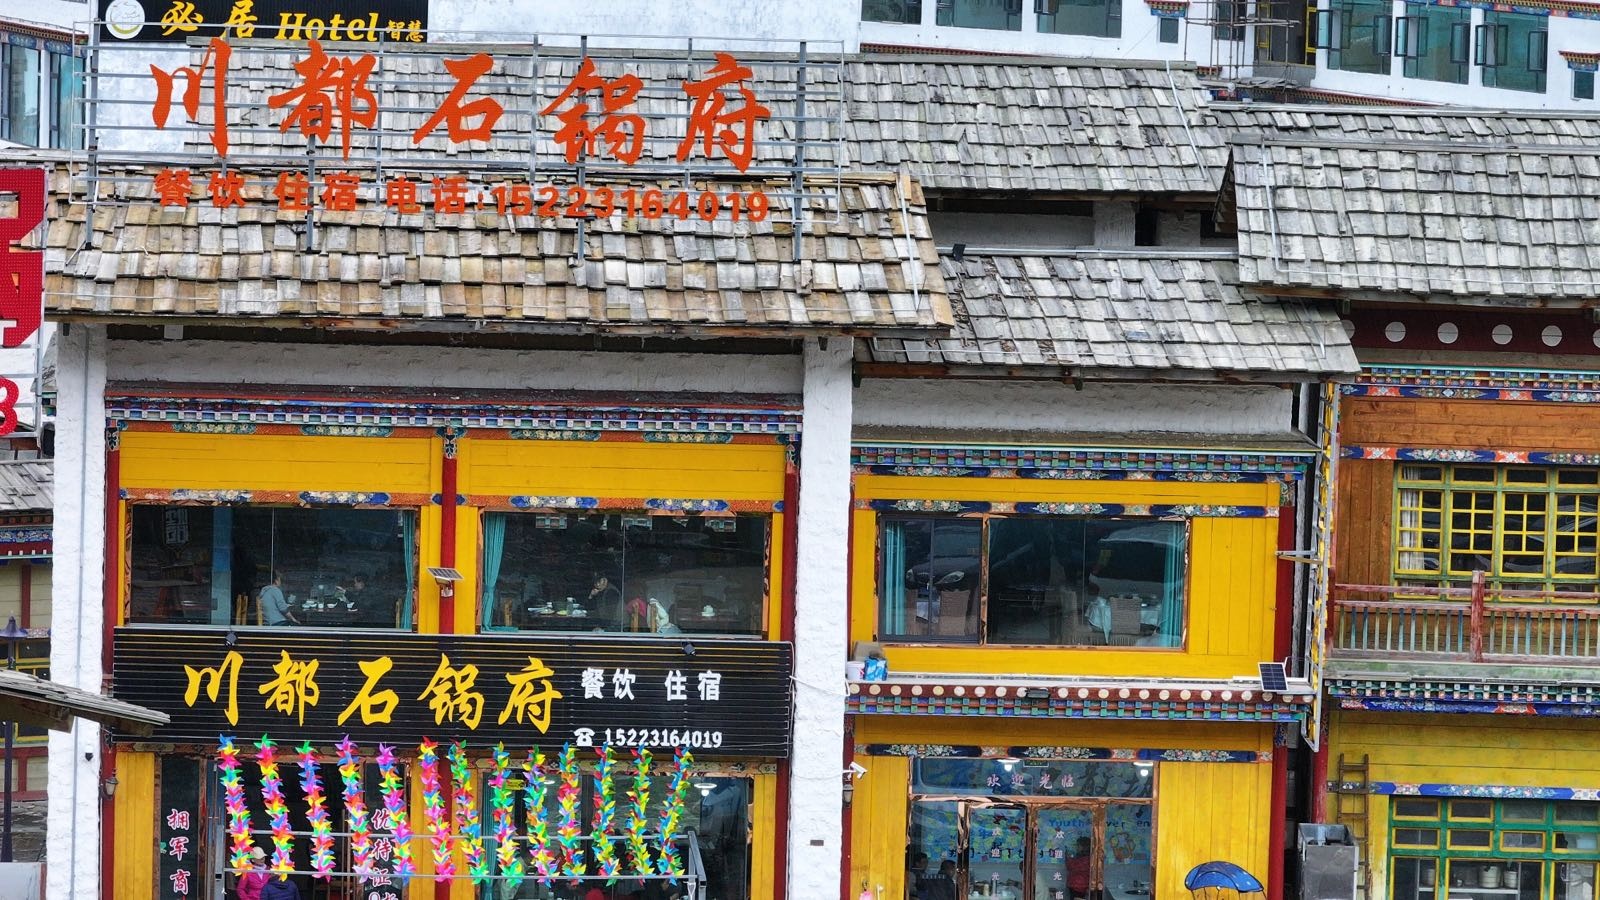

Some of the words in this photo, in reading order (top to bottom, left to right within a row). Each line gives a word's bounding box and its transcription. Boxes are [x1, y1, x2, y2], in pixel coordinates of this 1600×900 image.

[275, 13, 379, 41] Hotel
[151, 37, 770, 174] 川都石锅府
[154, 169, 245, 208] 餐饮
[274, 170, 360, 211] 住宿
[184, 650, 563, 734] 川都石锅府
[581, 667, 636, 700] 餐饮
[664, 670, 722, 701] 住宿
[604, 728, 722, 748] 15223164019
[987, 773, 1075, 790] 欢迎光临
